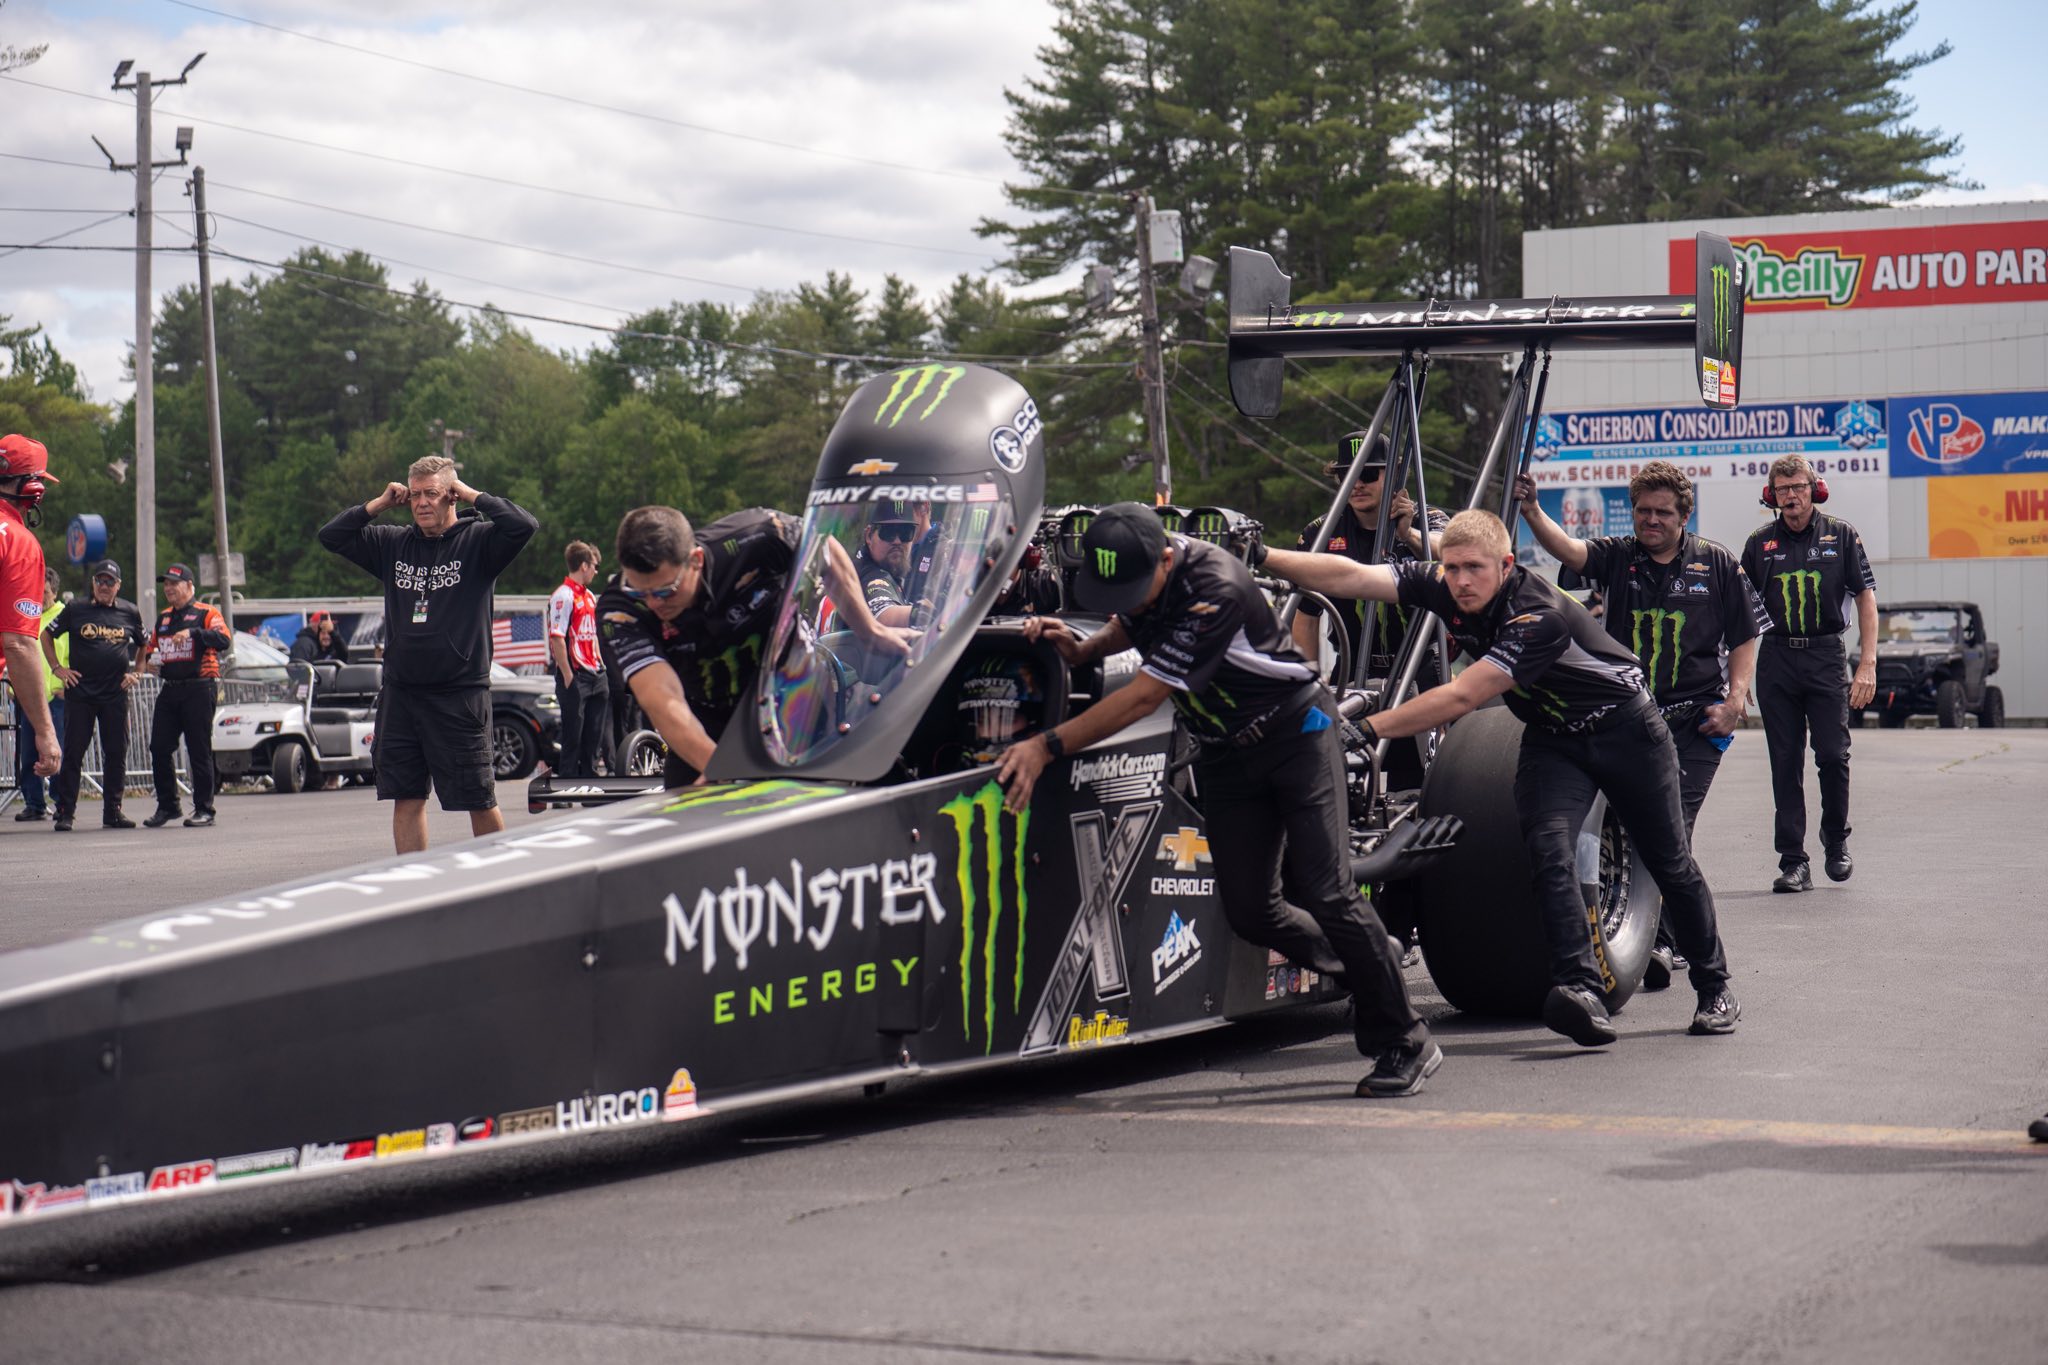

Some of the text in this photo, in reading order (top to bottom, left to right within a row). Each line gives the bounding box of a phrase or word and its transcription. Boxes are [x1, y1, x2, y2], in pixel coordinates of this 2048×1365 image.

[1871, 251, 1967, 291] AUTO
[1976, 249, 2048, 286] PAR
[1567, 405, 1830, 444] SCHERBON CONSOLIDATED INC.
[1908, 403, 1962, 462] VP
[1992, 415, 2048, 436] MAK
[1592, 447, 1679, 457] GENERATORS
[1699, 443, 1735, 455] PUMP
[1740, 440, 1805, 453] STATIONS
[868, 484, 965, 502] FORCE
[395, 560, 461, 577] GOD IS GOOD
[413, 580, 426, 592] IS
[428, 574, 461, 591] GOOD
[99, 626, 125, 638] Head
[1151, 877, 1215, 896] CHEVROLET
[662, 852, 946, 974] MONSTER
[1151, 917, 1201, 983] PEAK
[714, 956, 919, 1025] ENERGY
[555, 1086, 660, 1133] HURCO
[150, 1162, 215, 1193] ARP
